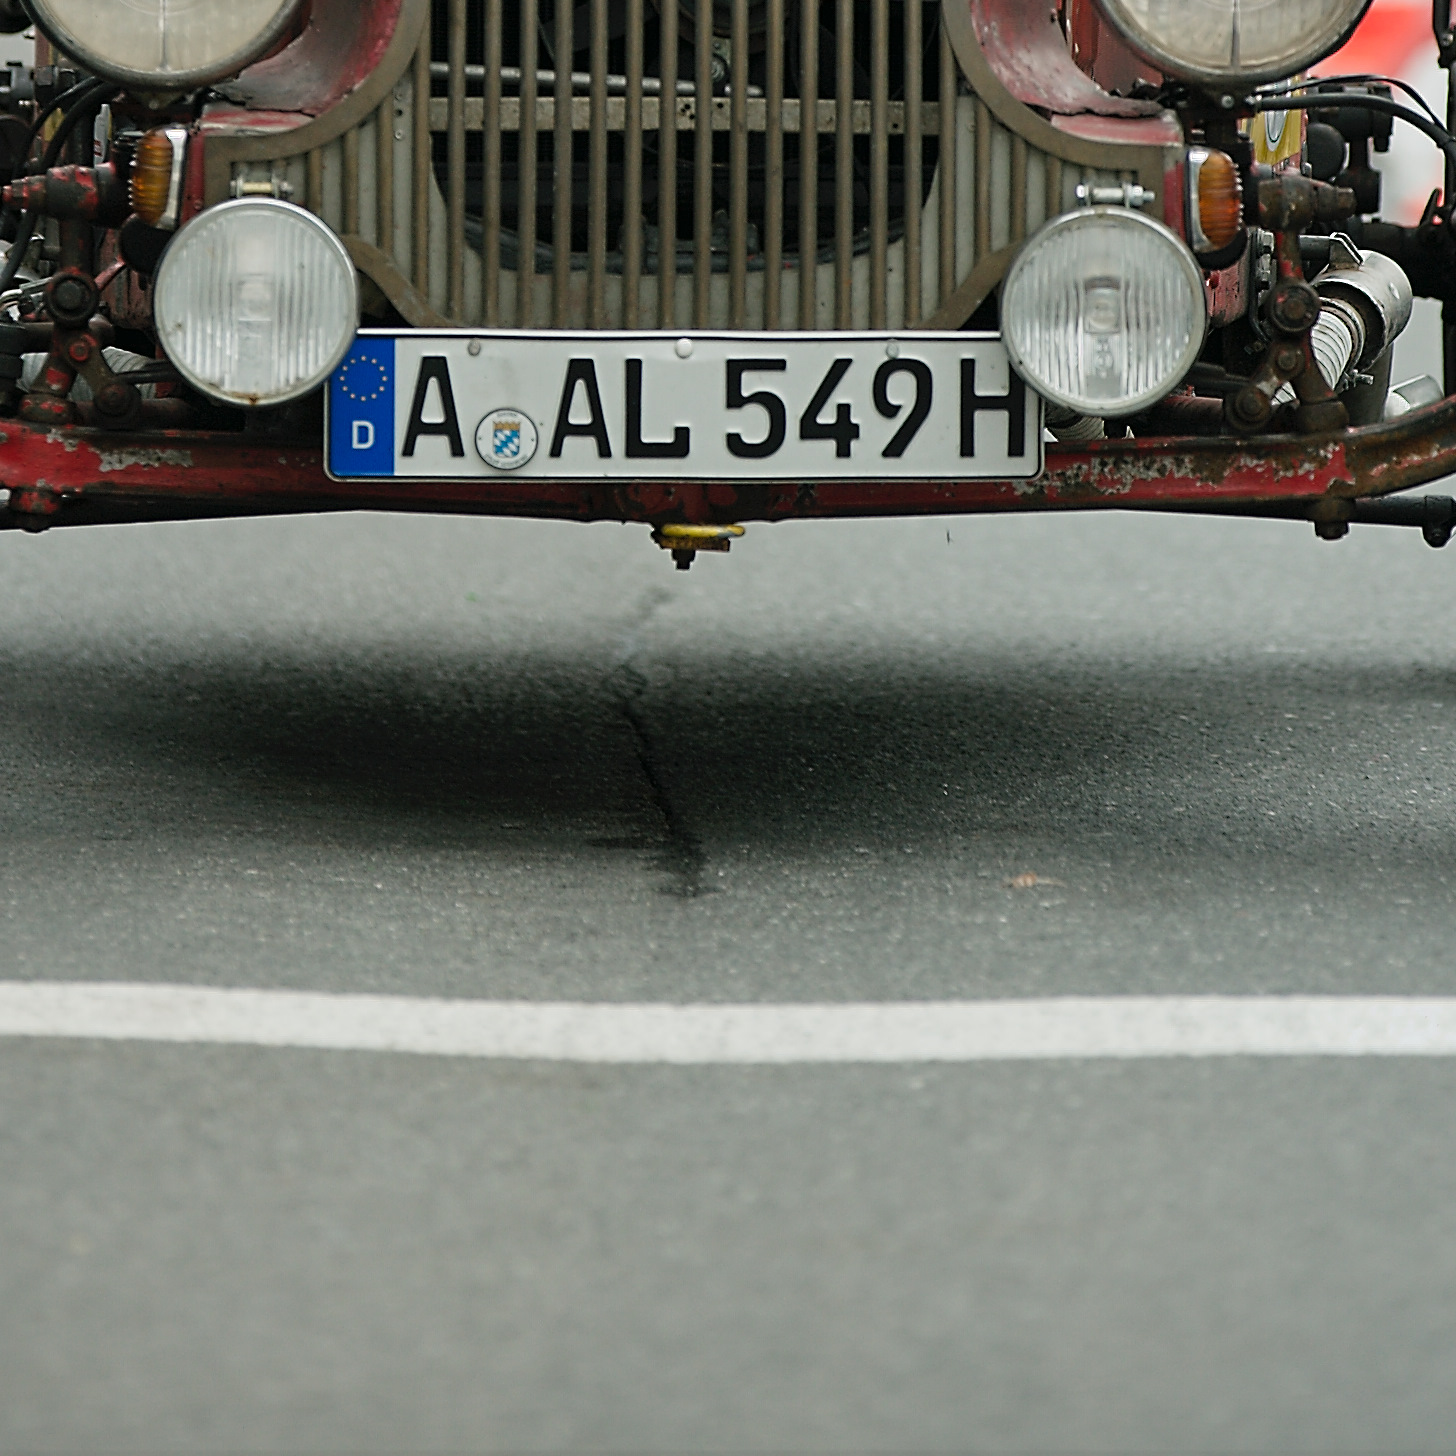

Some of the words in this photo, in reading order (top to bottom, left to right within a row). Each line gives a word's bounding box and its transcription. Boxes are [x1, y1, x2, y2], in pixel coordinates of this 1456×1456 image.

[351, 419, 375, 450] D
[401, 355, 465, 458] A
[549, 358, 691, 459] AL
